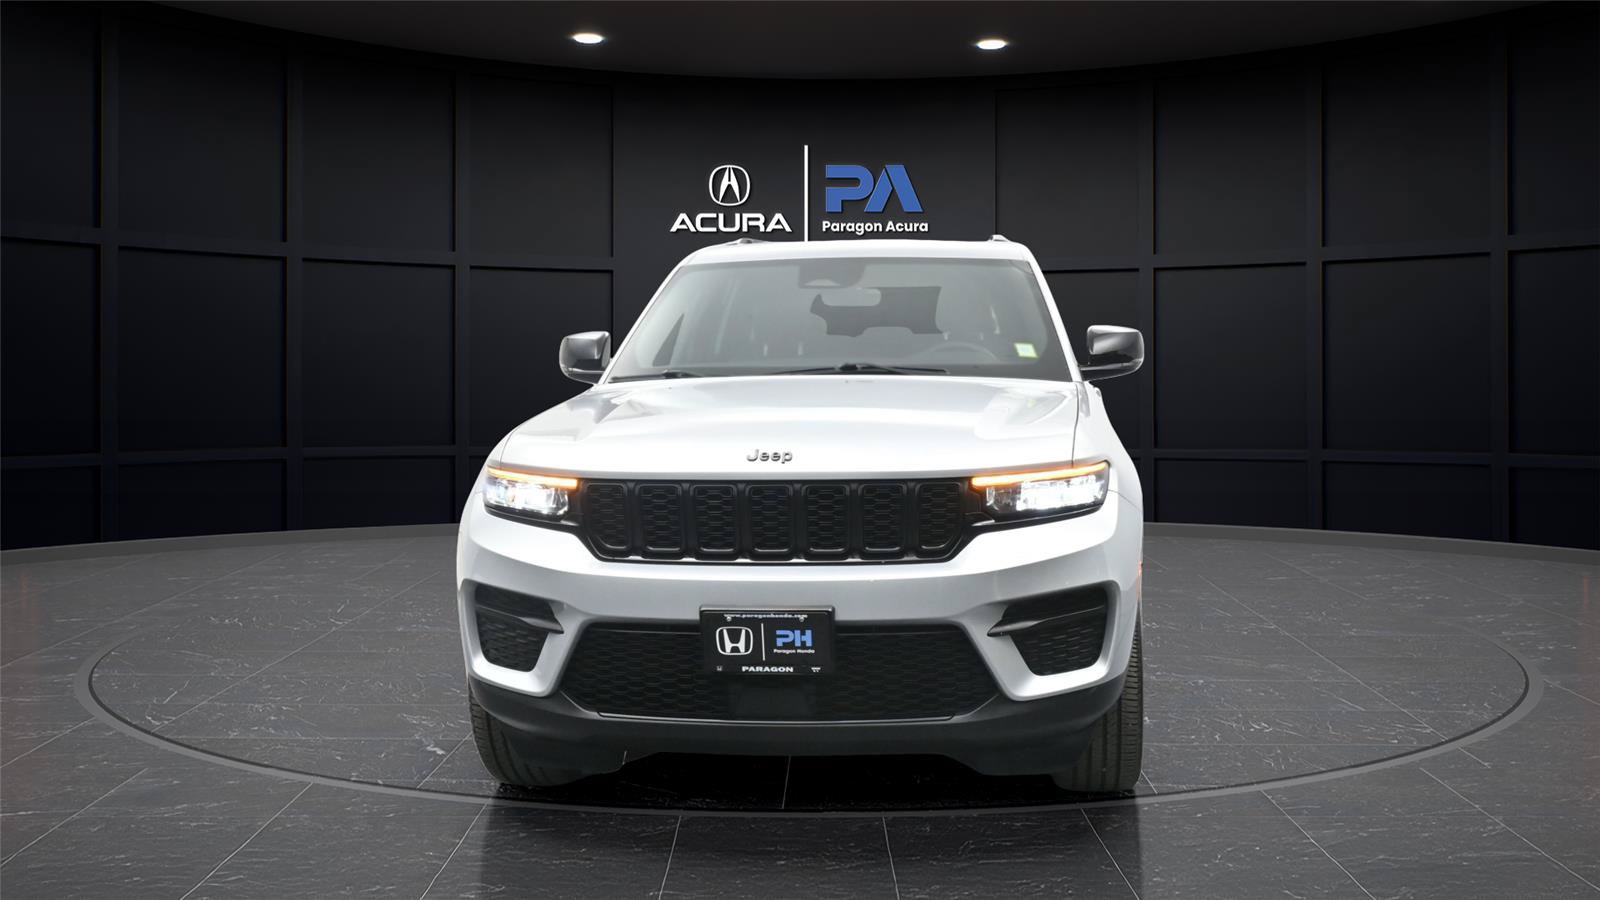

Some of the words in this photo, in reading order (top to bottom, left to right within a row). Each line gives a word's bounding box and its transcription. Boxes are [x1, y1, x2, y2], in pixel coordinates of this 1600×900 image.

[825, 164, 923, 213] PA
[669, 212, 793, 233] ACURA
[822, 220, 883, 236] Paragon
[885, 220, 929, 233] Acura
[746, 448, 793, 465] Jeep
[775, 629, 813, 647] PH
